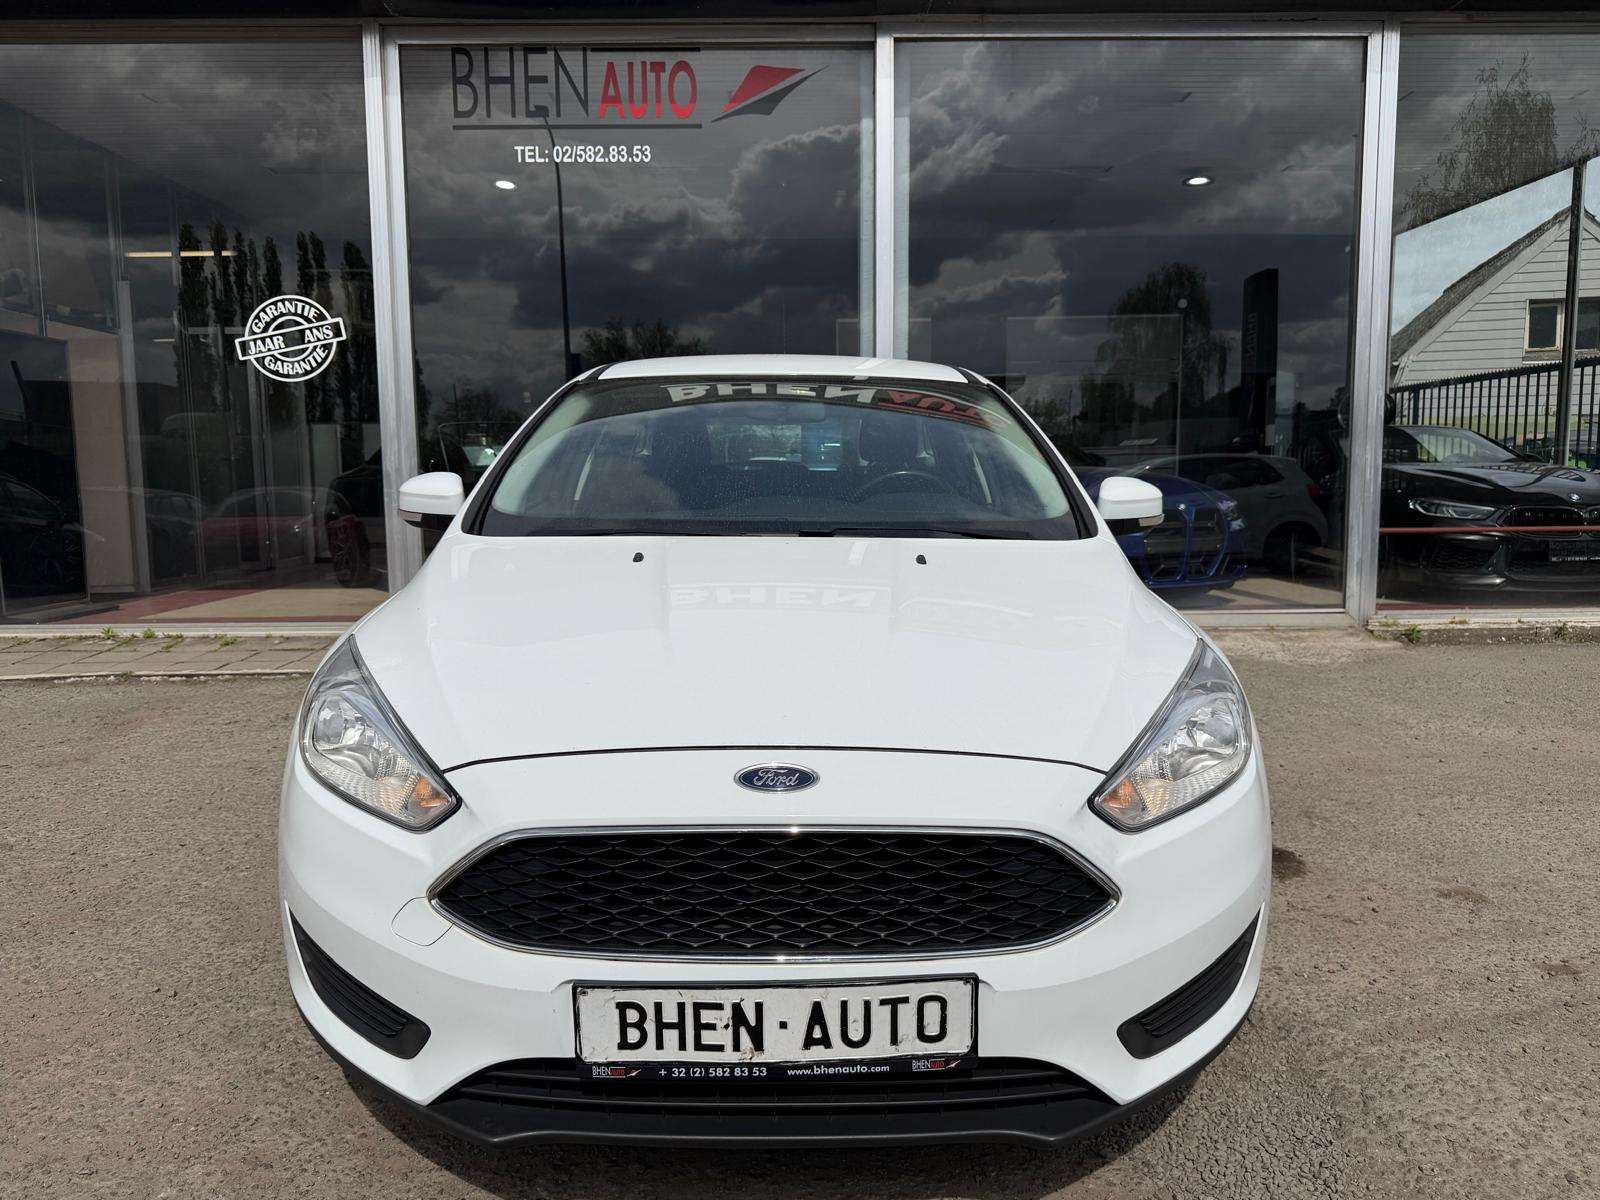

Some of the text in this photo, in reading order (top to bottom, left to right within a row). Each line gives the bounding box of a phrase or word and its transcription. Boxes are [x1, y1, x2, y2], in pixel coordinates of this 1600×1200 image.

[451, 46, 699, 119] BHEN AUTO
[514, 145, 651, 163] TEL: 02/582.83.53
[251, 301, 320, 333] GARANTIE
[248, 325, 333, 355] JAAR ANS
[264, 344, 328, 375] GARANTIE
[753, 768, 800, 786] Ford
[615, 999, 765, 1053] BHEN
[801, 993, 948, 1051] AUTO
[671, 1067, 686, 1077] 32
[690, 1067, 705, 1078] (2)
[708, 1067, 731, 1077] 582
[734, 1067, 749, 1077] 83
[752, 1067, 767, 1076] 53
[787, 1064, 890, 1076] www.bhenauto.com
